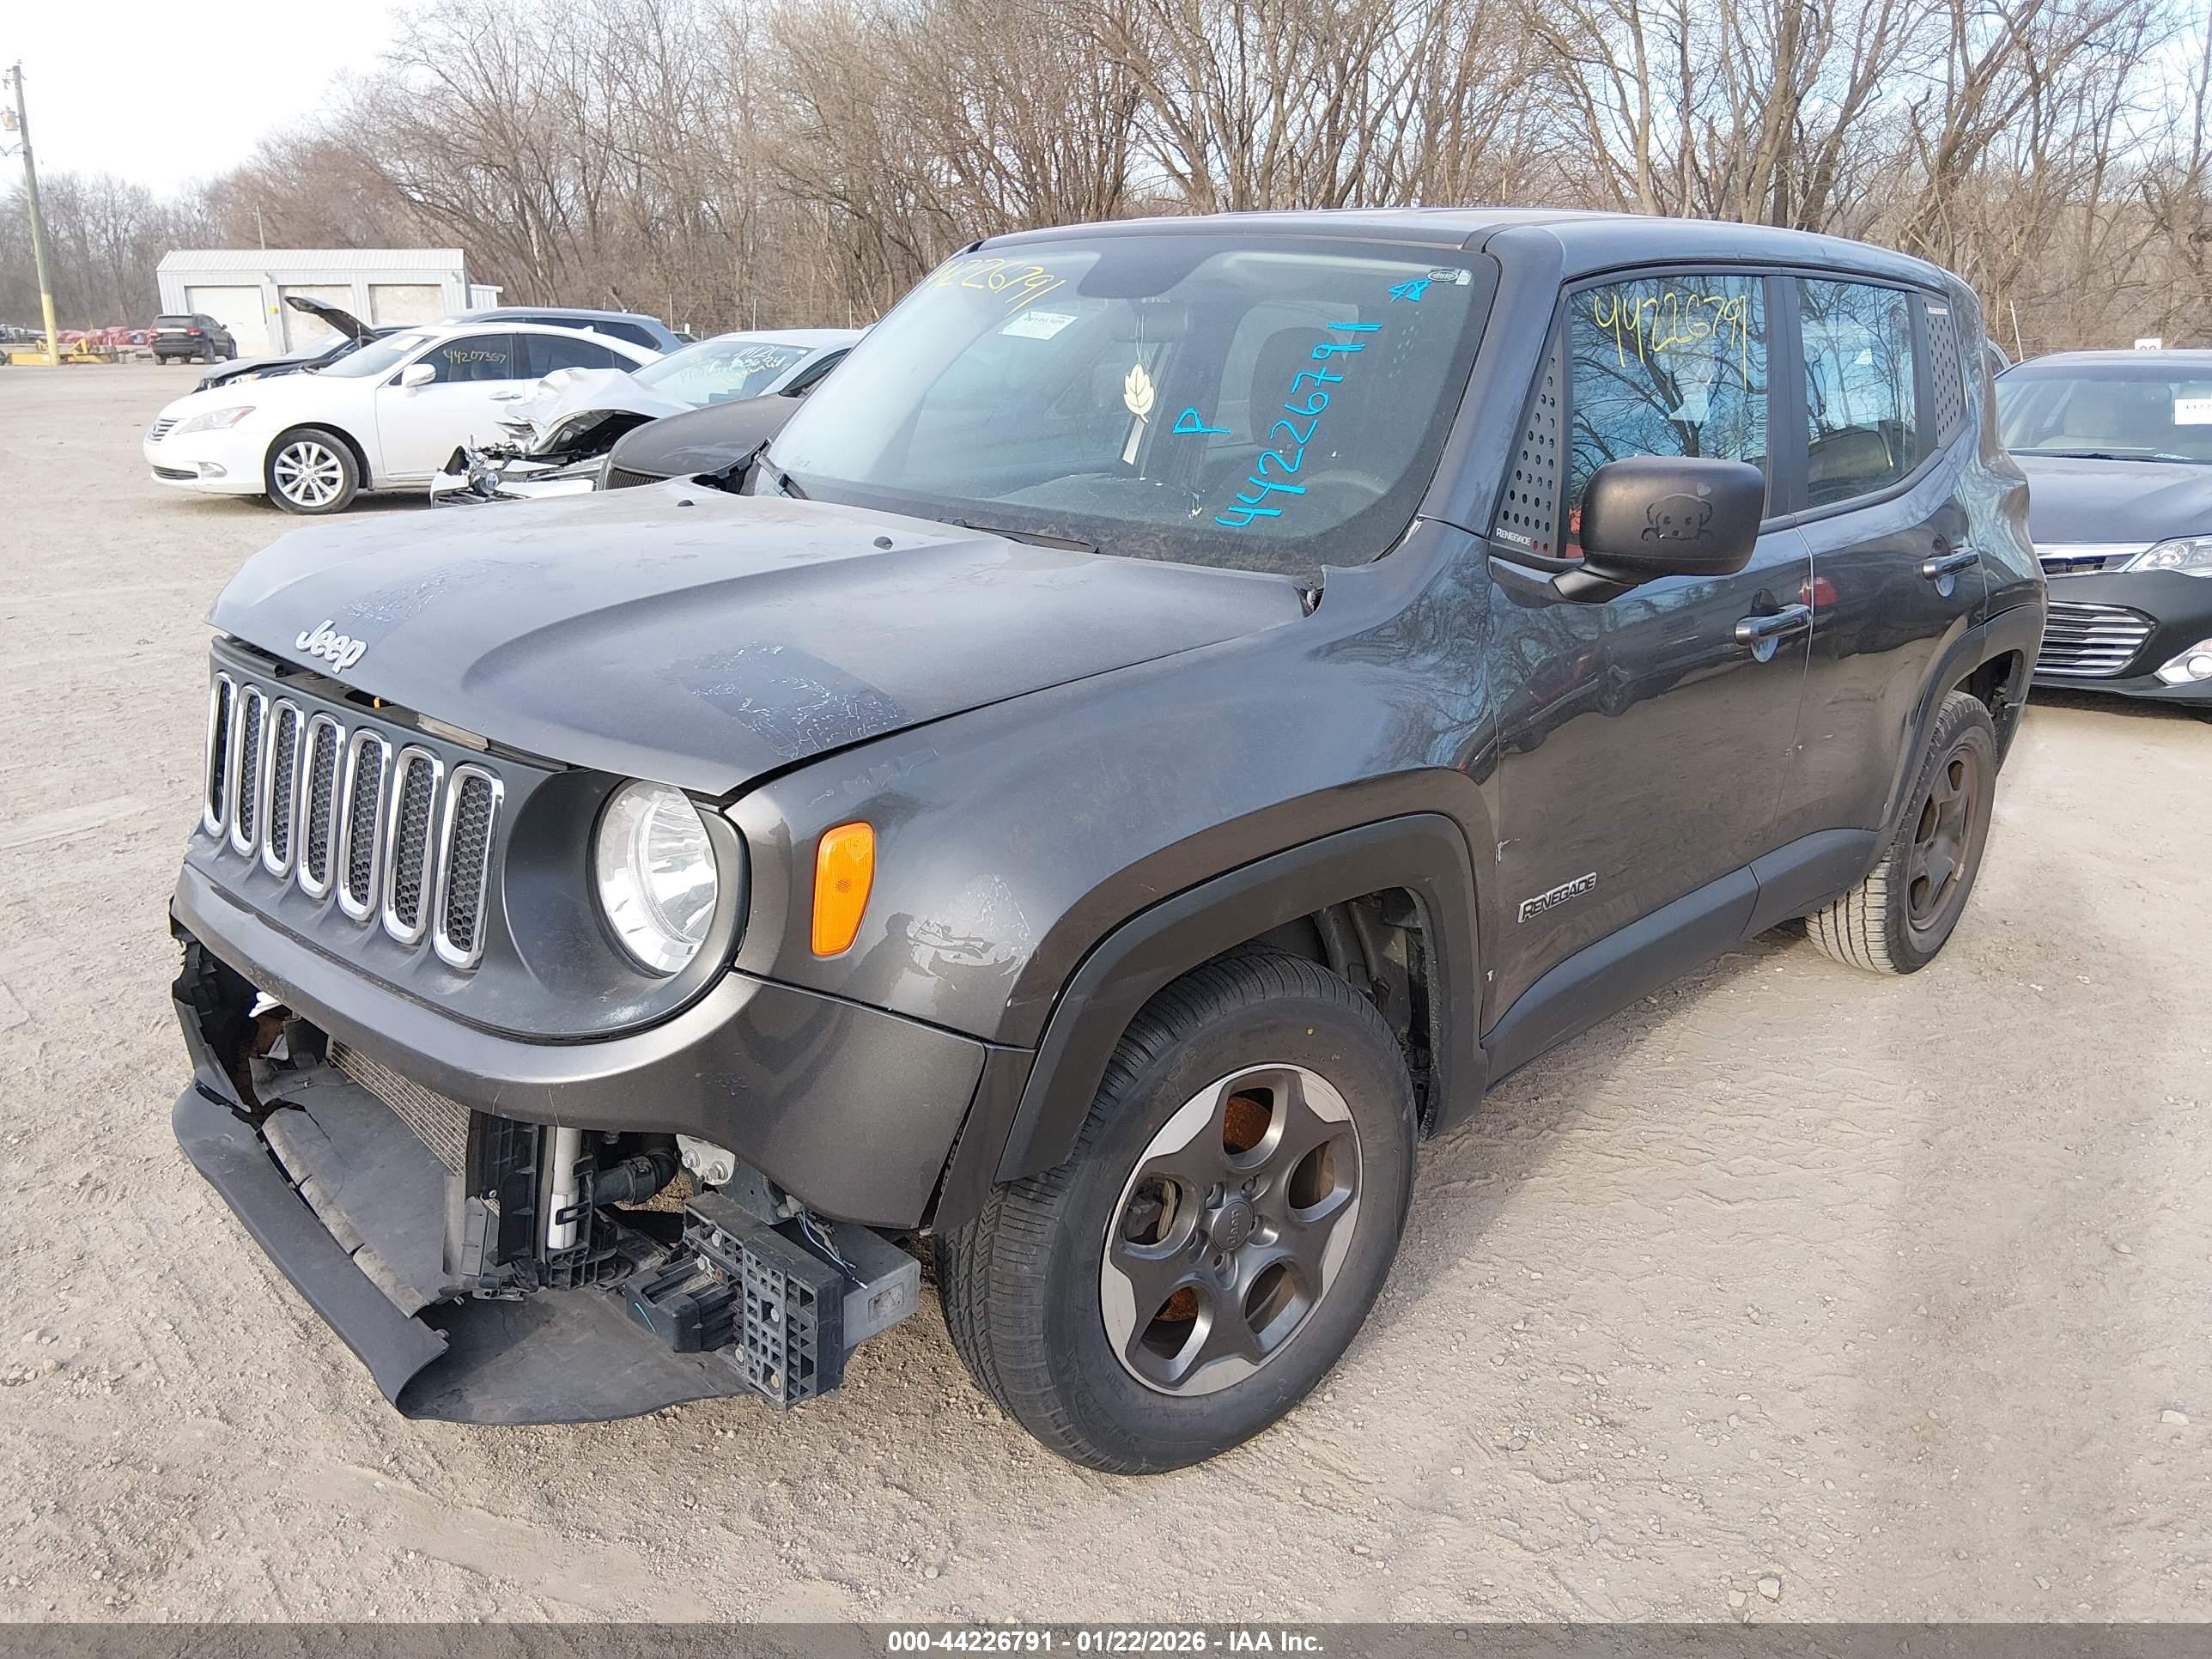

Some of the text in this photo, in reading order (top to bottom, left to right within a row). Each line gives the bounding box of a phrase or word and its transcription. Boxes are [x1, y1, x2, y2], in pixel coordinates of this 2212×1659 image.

[1594, 292, 1749, 394] 44226791
[1214, 321, 1384, 527] 44226791
[1496, 527, 1532, 546] RENEGADE
[295, 619, 368, 674] Jeep
[1517, 872, 1597, 923] RENEGADE
